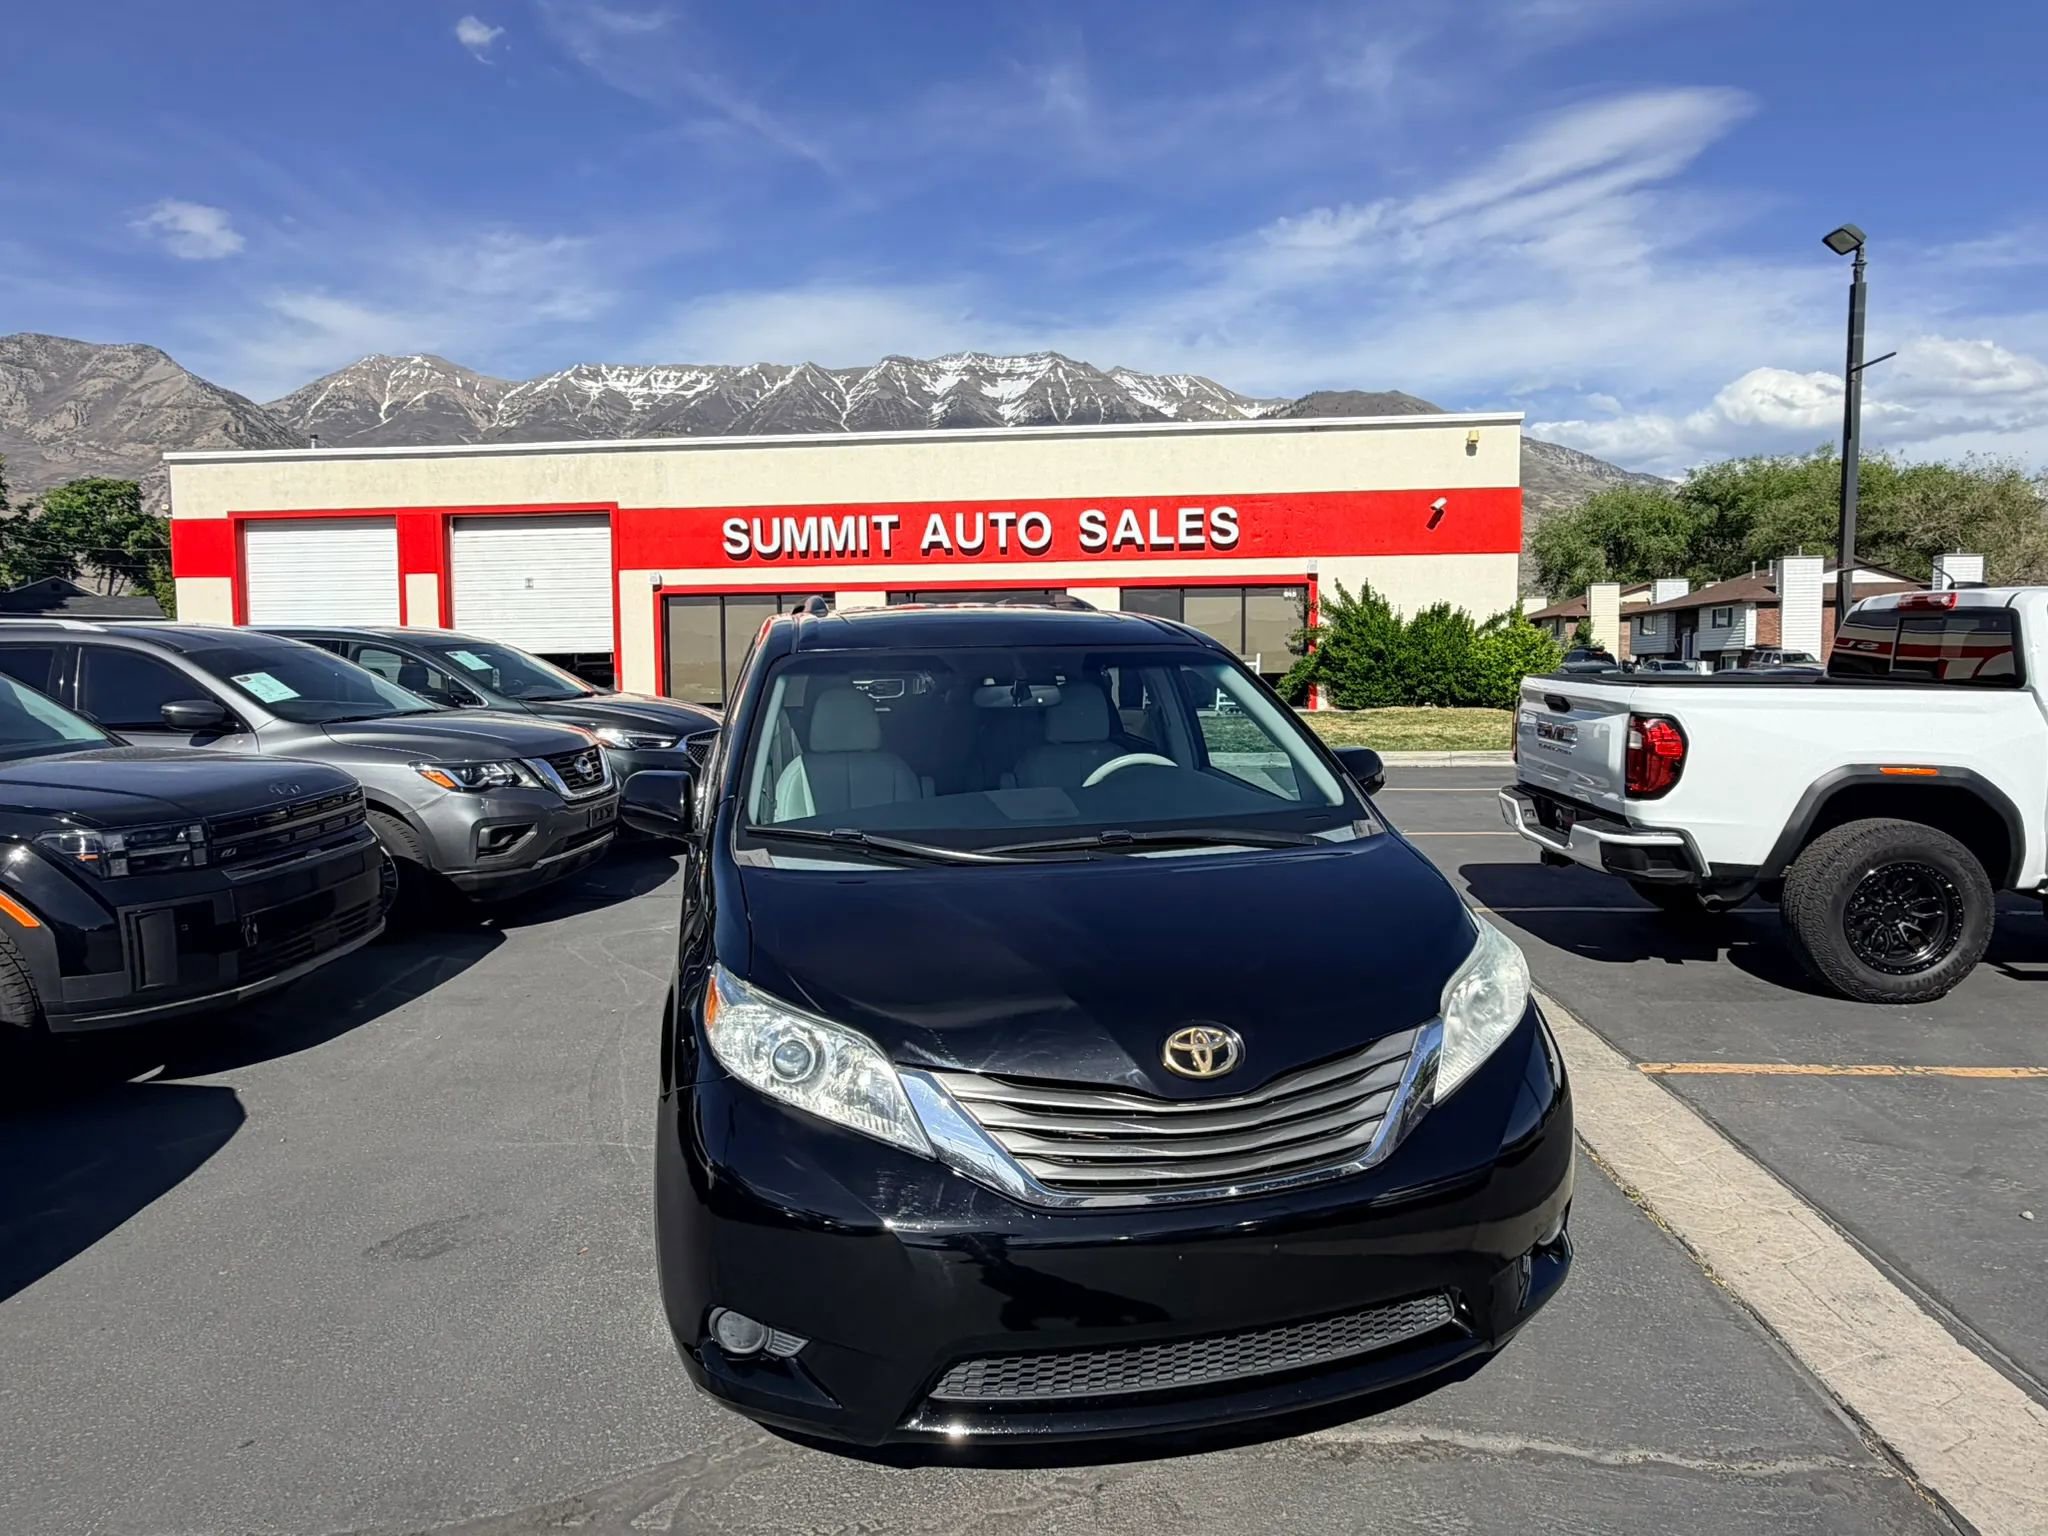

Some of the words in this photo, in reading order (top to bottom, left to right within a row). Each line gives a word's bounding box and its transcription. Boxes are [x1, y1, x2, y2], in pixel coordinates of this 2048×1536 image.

[722, 514, 899, 555] SUMMIT
[920, 511, 1052, 550] AUTO
[1079, 506, 1239, 547] SALES
[1537, 721, 1578, 744] GMC
